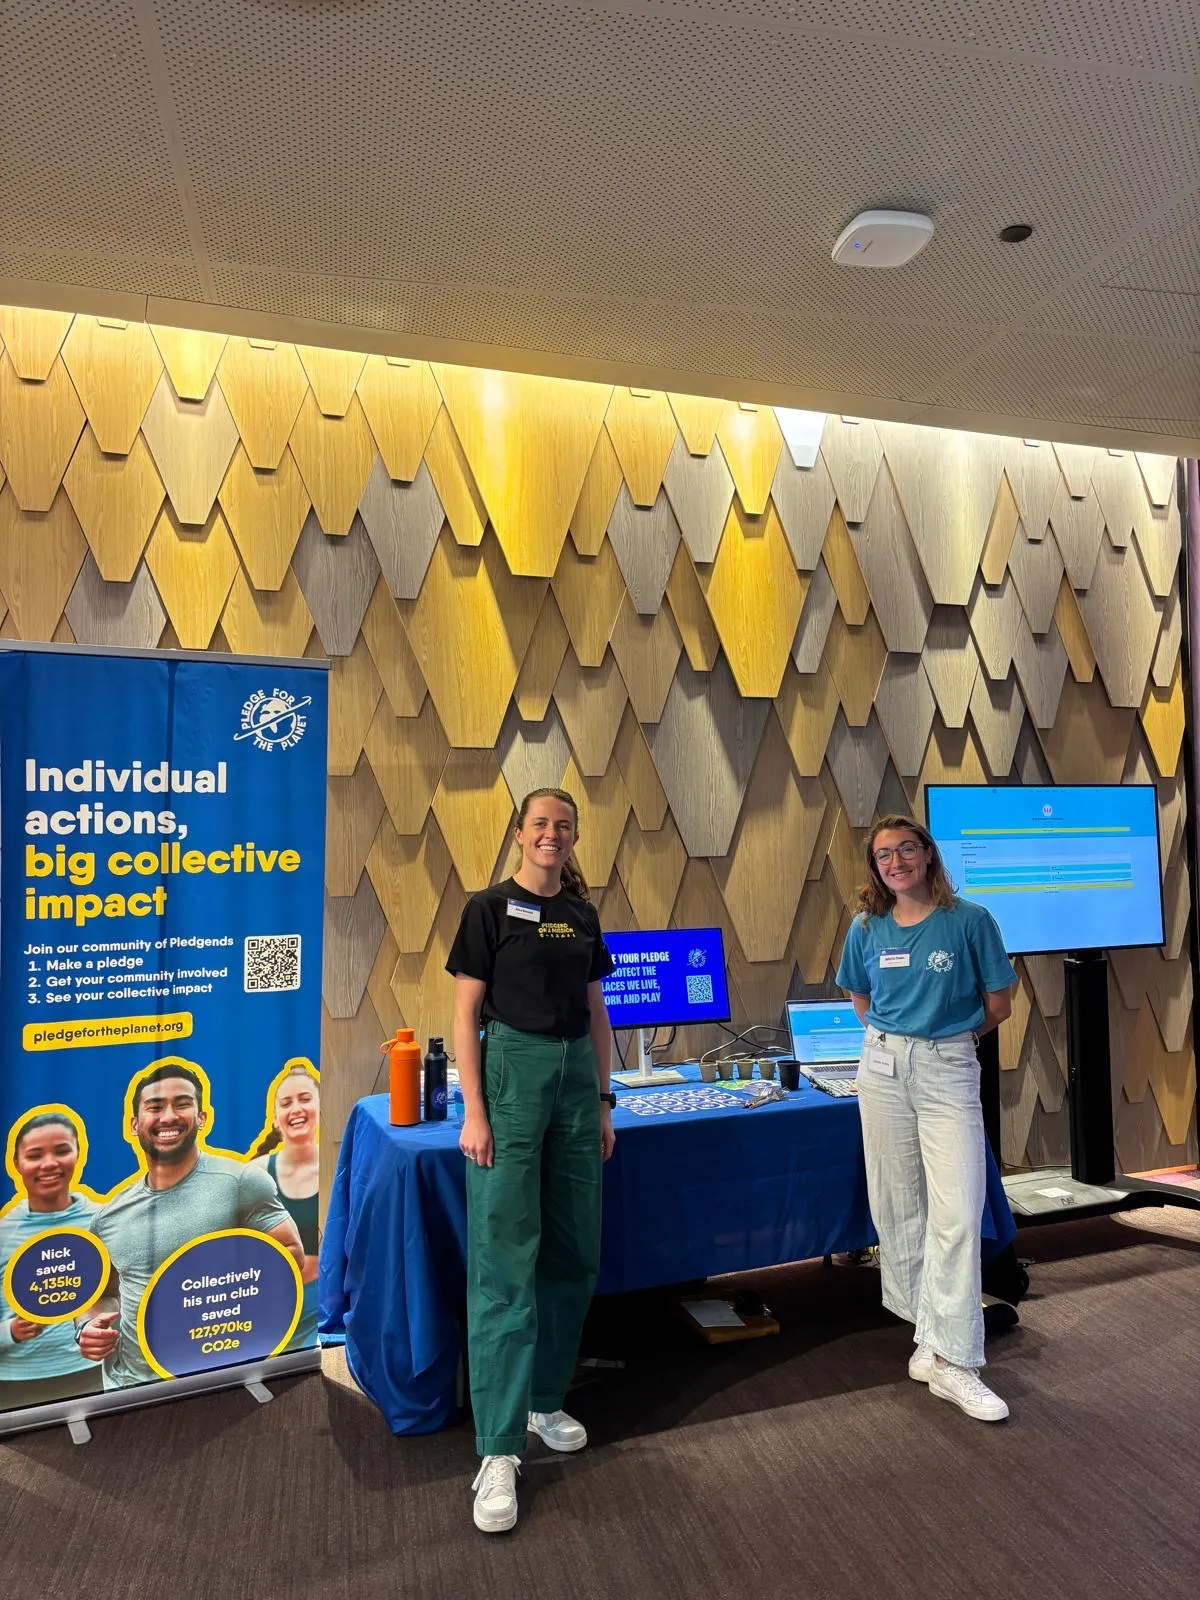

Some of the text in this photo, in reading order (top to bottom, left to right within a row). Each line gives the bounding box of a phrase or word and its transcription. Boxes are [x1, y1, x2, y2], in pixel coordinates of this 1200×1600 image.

[241, 688, 295, 730] PLEDGE FOR
[253, 714, 307, 752] THE PLANET
[25, 758, 227, 793] Individual
[24, 802, 188, 840] actions,
[25, 842, 301, 886] big collective
[25, 886, 167, 926] impact
[24, 936, 234, 955] Join our community of Pledgends
[28, 956, 144, 972] 1. Make a pledge
[618, 953, 640, 964] YOUR
[641, 951, 670, 963] PLEDGE
[28, 967, 228, 988] 2. Get your community involved
[641, 965, 657, 976] THE
[28, 983, 213, 1004] 3. See your collective impact
[601, 979, 660, 993] LACES WE LIVE,
[604, 992, 661, 1006] ORK AND PLAY
[33, 1021, 184, 1044] pledgefortheplanet.org
[41, 1247, 71, 1261] Nick
[36, 1260, 76, 1276] saved
[29, 1275, 82, 1293] 4,135kg
[181, 1267, 261, 1291] Collectively
[38, 1290, 77, 1305] CO2e
[183, 1285, 259, 1308] his run club
[201, 1304, 241, 1321] saved
[189, 1320, 252, 1340] 127,970kg
[201, 1338, 240, 1354] CO2e
